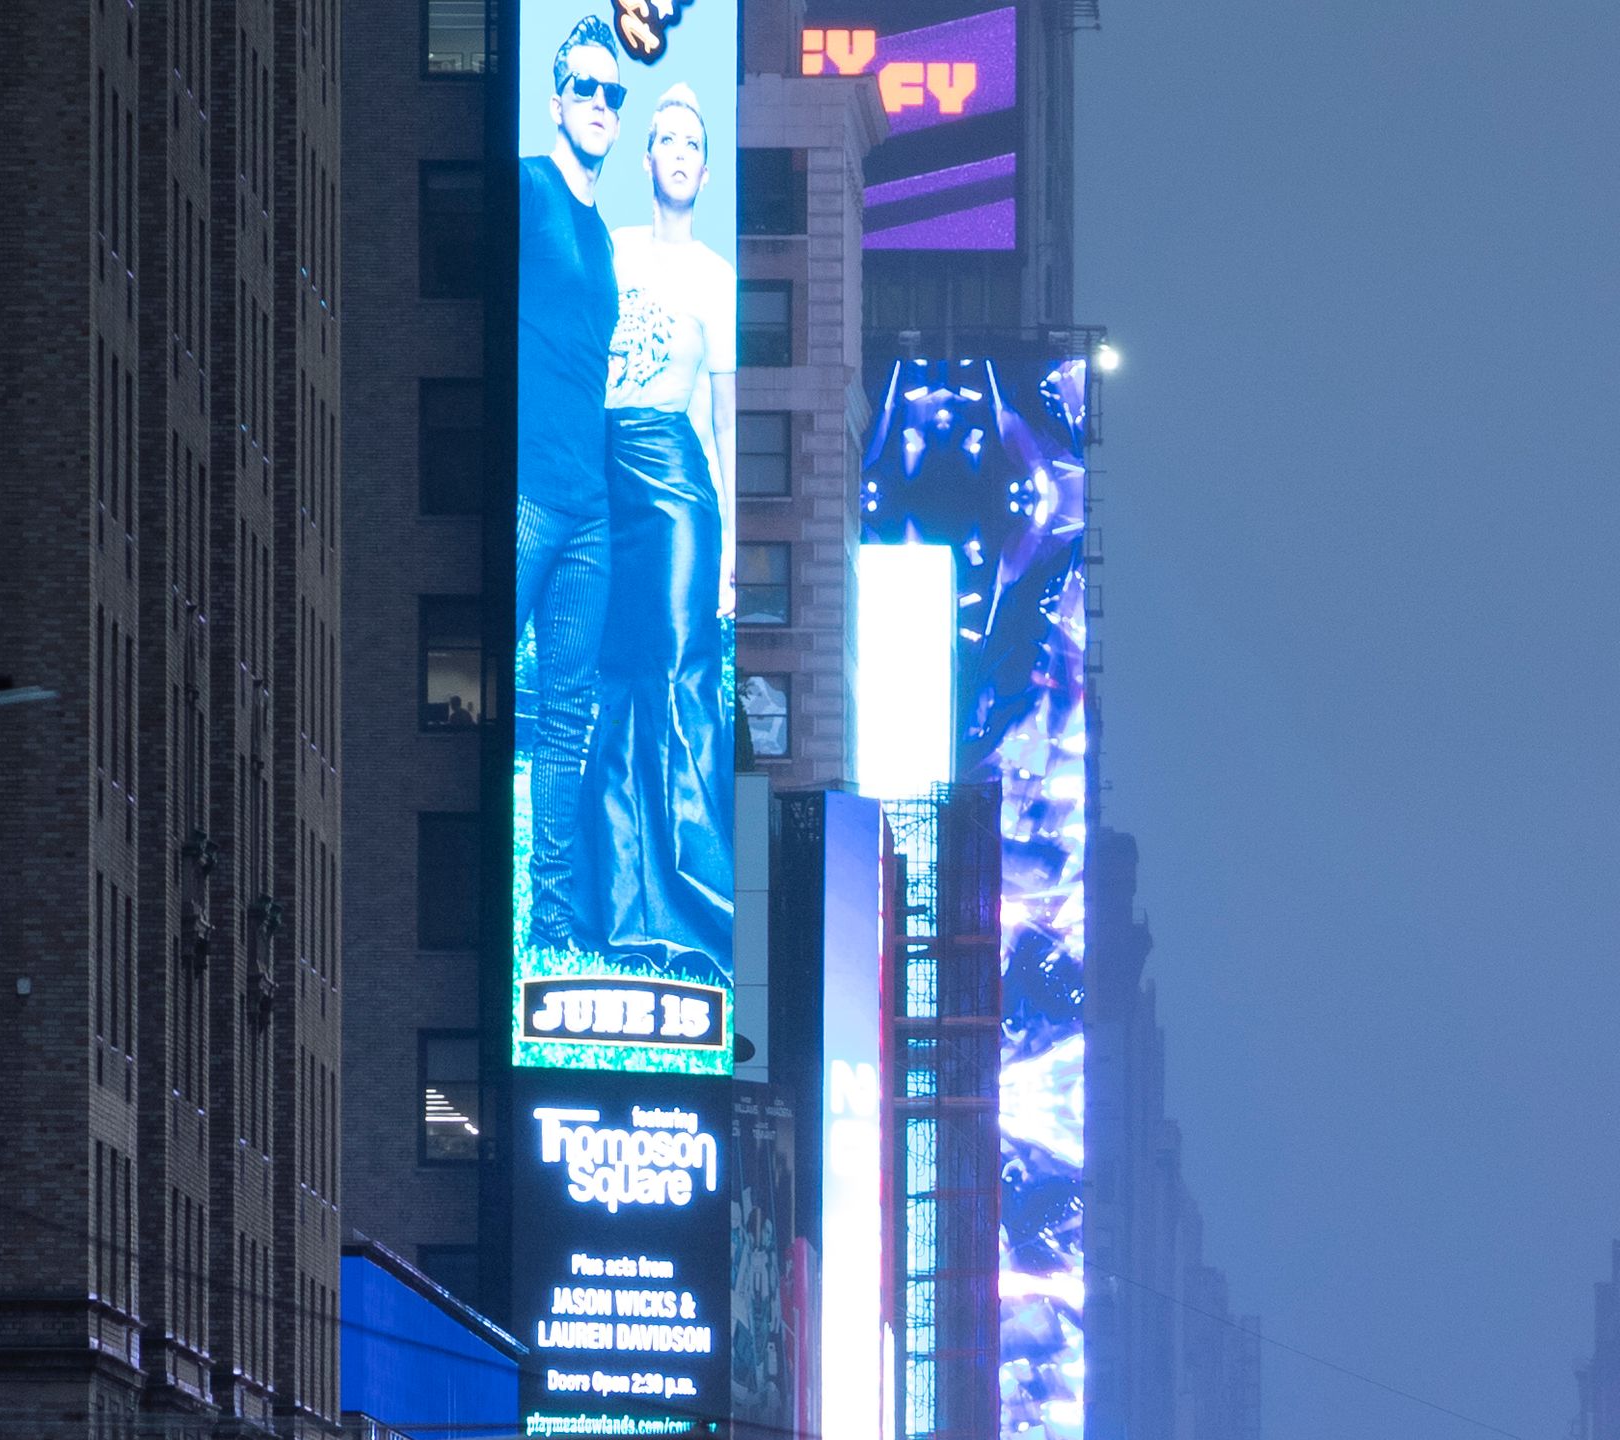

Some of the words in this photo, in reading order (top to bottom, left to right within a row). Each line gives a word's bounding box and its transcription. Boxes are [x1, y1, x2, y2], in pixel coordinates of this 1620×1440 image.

[533, 990, 655, 1034] JUNE
[660, 994, 710, 1037] 15
[632, 1105, 698, 1133] featuring
[533, 1107, 717, 1191] Thompson
[568, 1158, 693, 1213] Square
[571, 1254, 604, 1276] Plus
[605, 1257, 637, 1277] acts
[638, 1256, 674, 1278] from
[551, 1287, 612, 1316] JASON
[615, 1289, 677, 1318] WICKS
[679, 1291, 697, 1319] &
[538, 1320, 613, 1349] LAUREN
[616, 1323, 712, 1353] DAVIDSON
[547, 1369, 590, 1392] Doors
[592, 1371, 630, 1397] Open
[526, 1411, 717, 1437] playmeadowlands.com/couy
